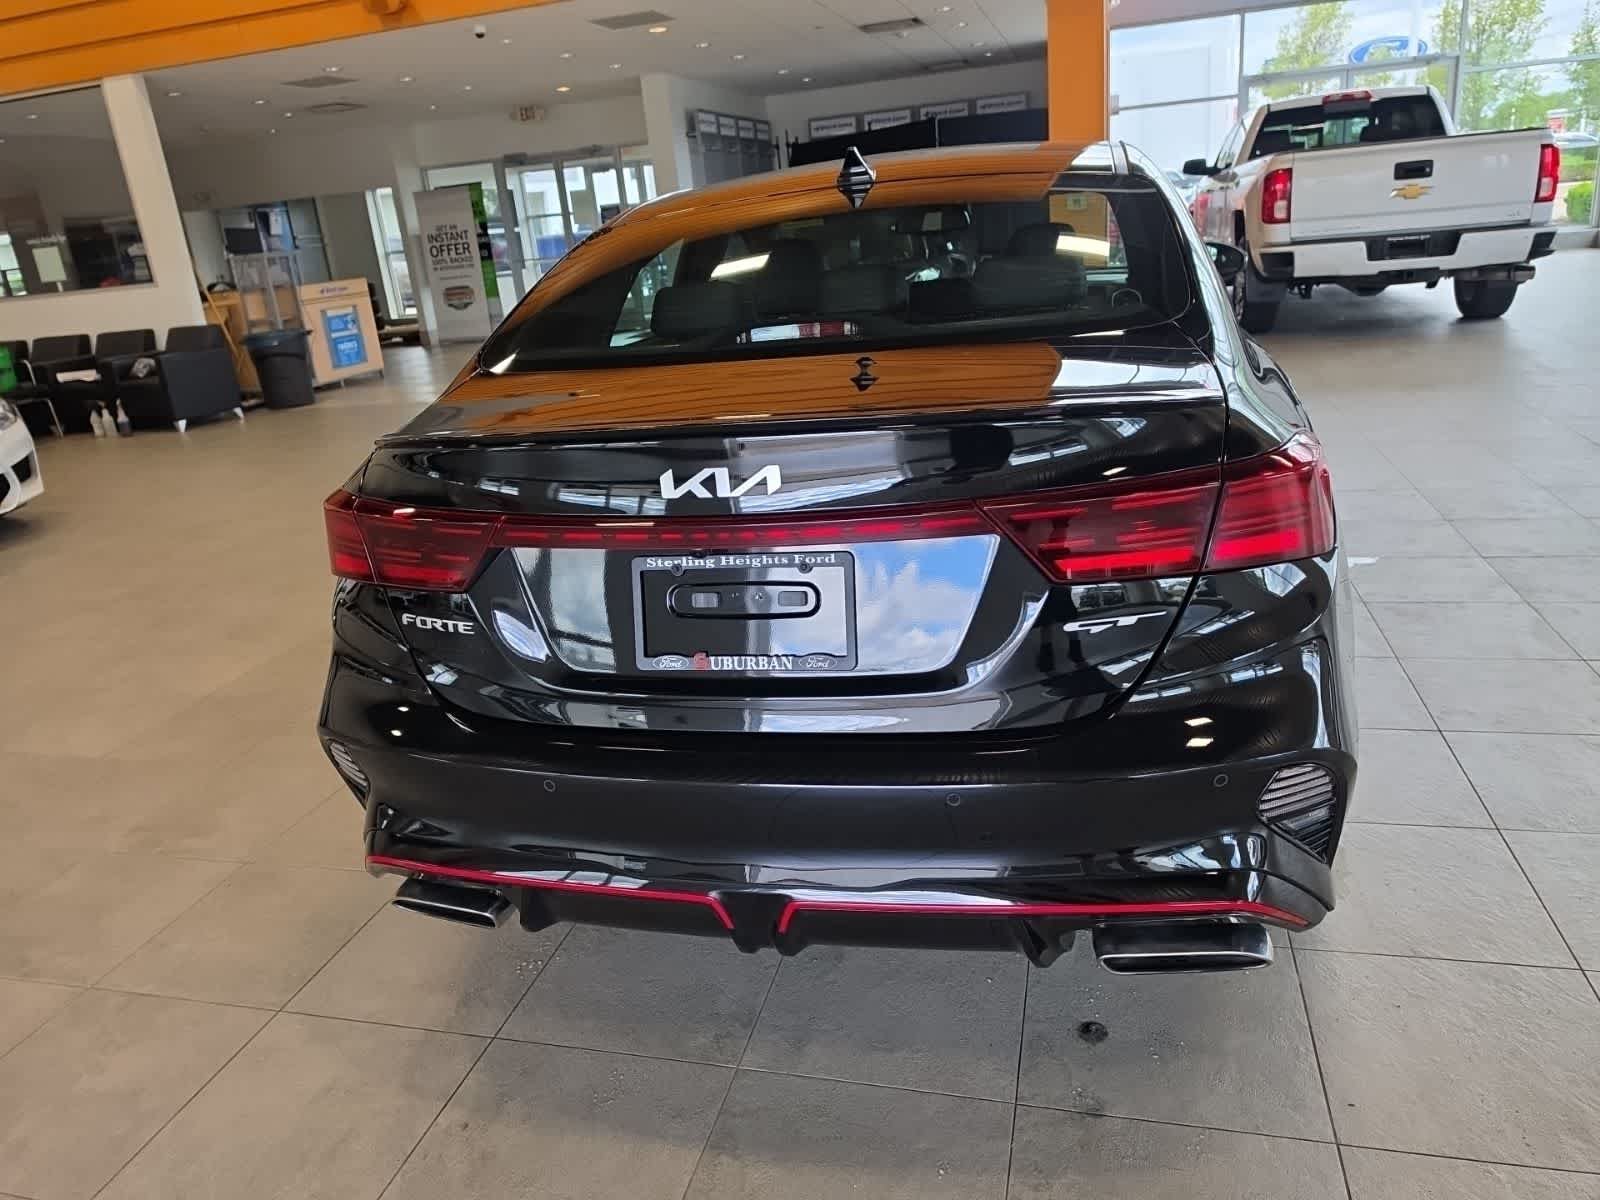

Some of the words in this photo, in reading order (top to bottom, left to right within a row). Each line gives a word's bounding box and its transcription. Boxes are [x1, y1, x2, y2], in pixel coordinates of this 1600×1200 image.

[426, 230, 469, 244] INSTANT
[429, 242, 472, 258] OFFER
[660, 465, 781, 498] KIA
[646, 556, 715, 568] Sterling
[720, 553, 789, 568] Heights
[793, 553, 836, 565] Ford
[401, 613, 475, 635] FORTE
[1063, 611, 1167, 633] GT
[657, 656, 684, 669] Ford
[693, 652, 793, 670] SUBURBAN
[804, 656, 832, 669] Ford
